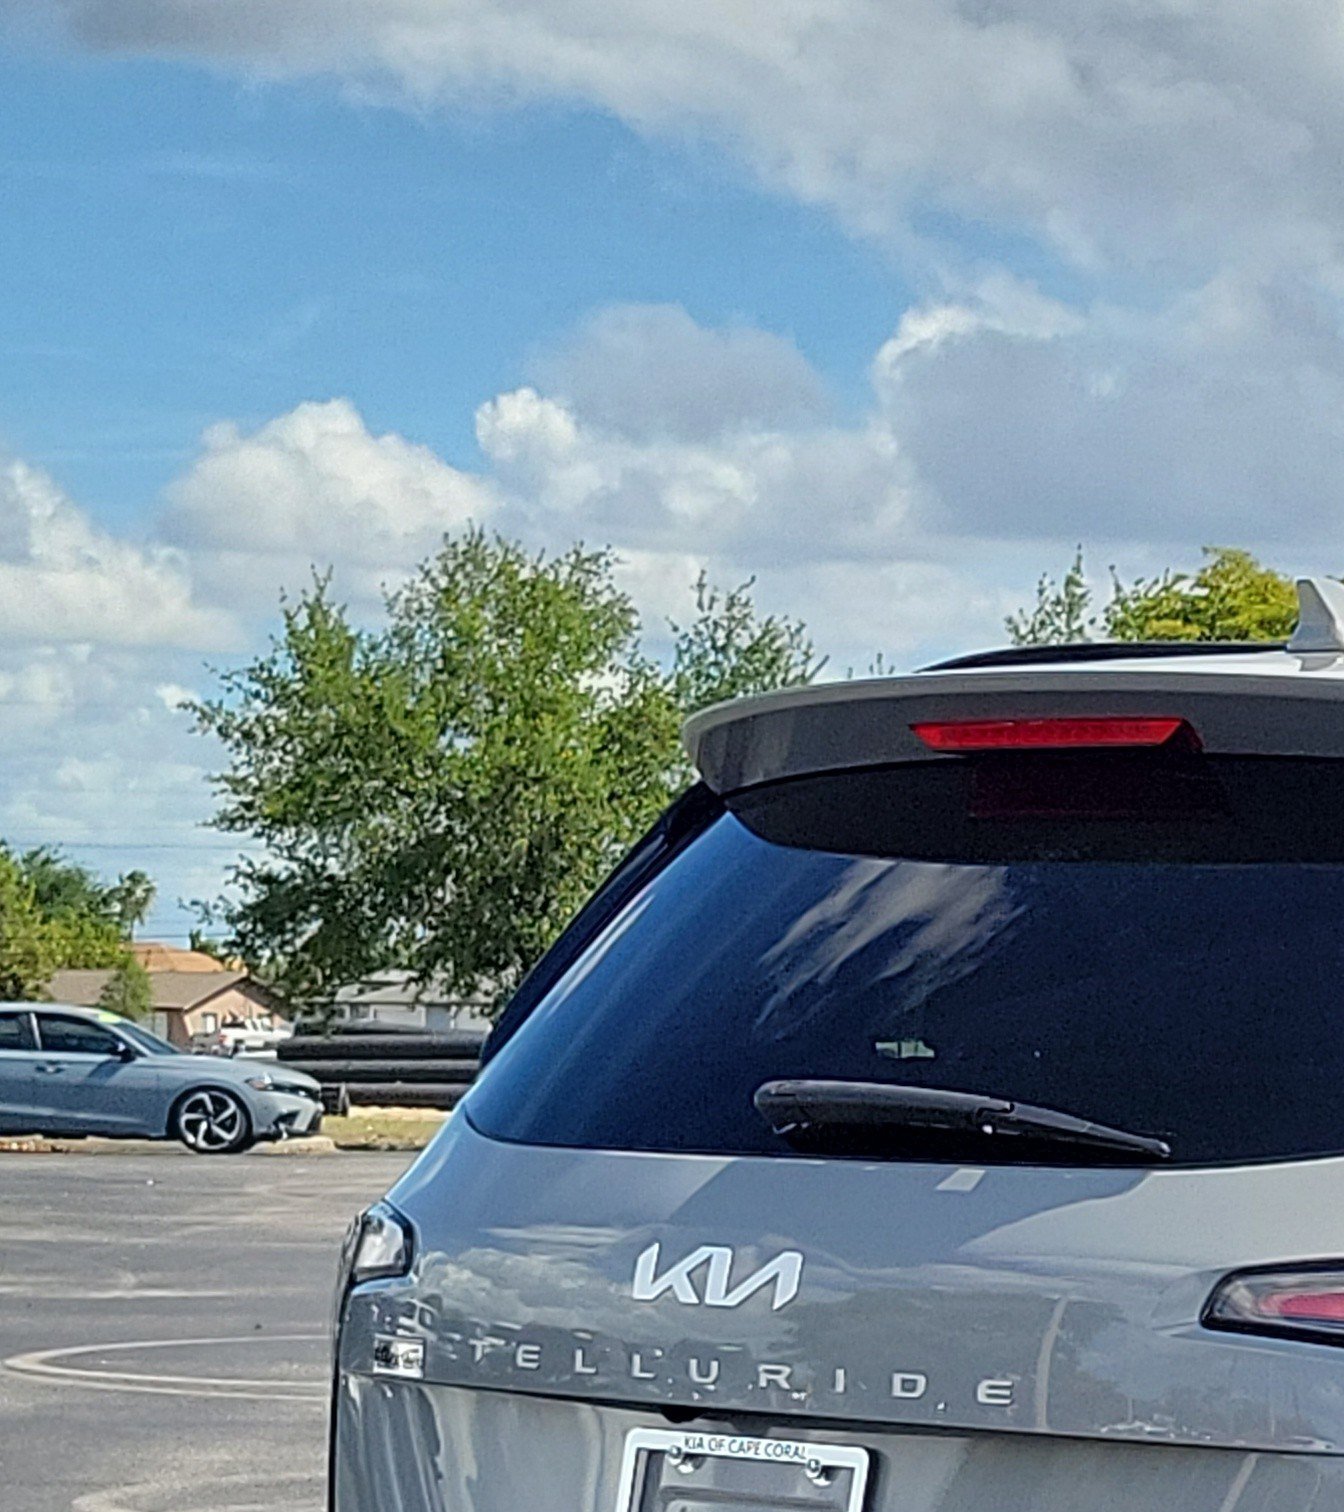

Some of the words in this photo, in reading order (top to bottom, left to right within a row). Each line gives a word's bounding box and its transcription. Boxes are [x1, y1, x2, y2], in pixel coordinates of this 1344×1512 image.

[470, 1337, 1014, 1406] TELLURIDE
[684, 1436, 705, 1450] KIA
[708, 1438, 726, 1451] OF
[728, 1438, 762, 1456] CAPE
[764, 1442, 807, 1460] CORAL
